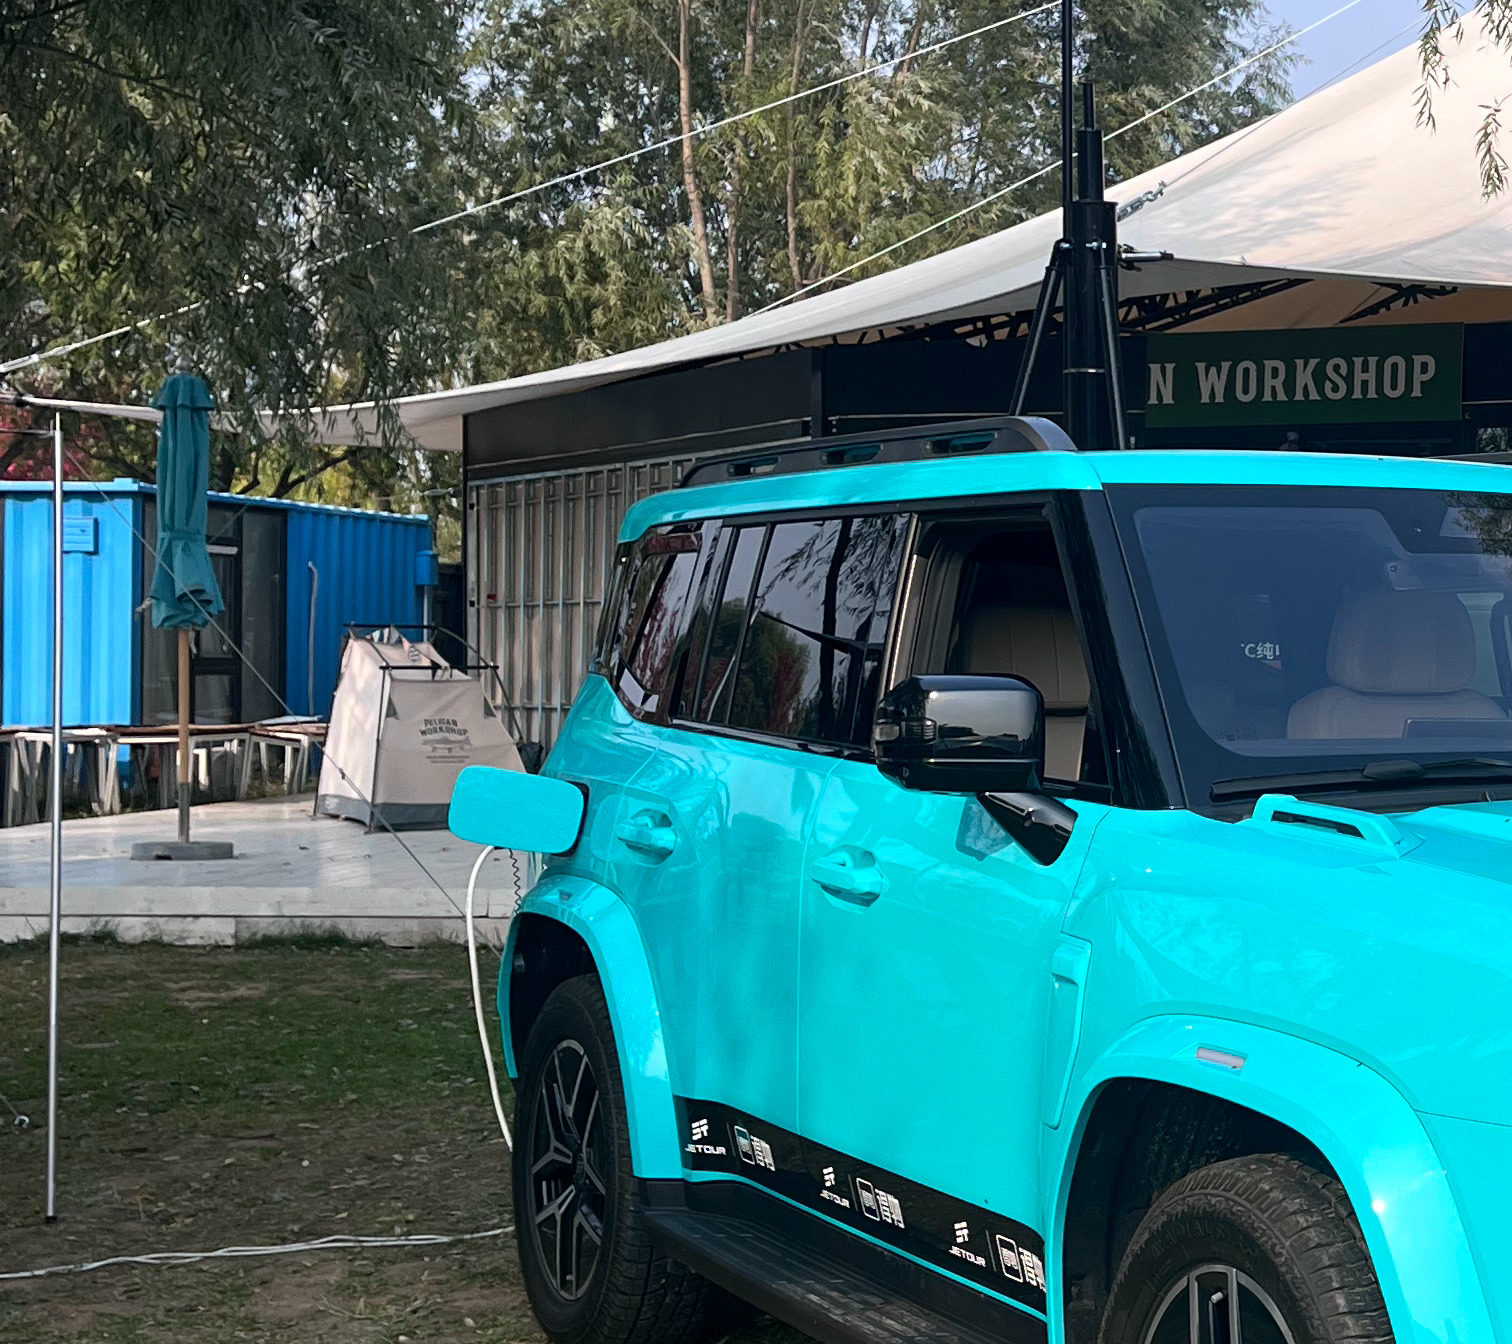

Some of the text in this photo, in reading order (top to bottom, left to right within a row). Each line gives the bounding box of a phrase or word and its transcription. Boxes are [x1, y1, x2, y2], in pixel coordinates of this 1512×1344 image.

[1195, 355, 1436, 403] WORKSHOP
[684, 1143, 727, 1156] JETOUR
[948, 1245, 986, 1268] JETOUR
